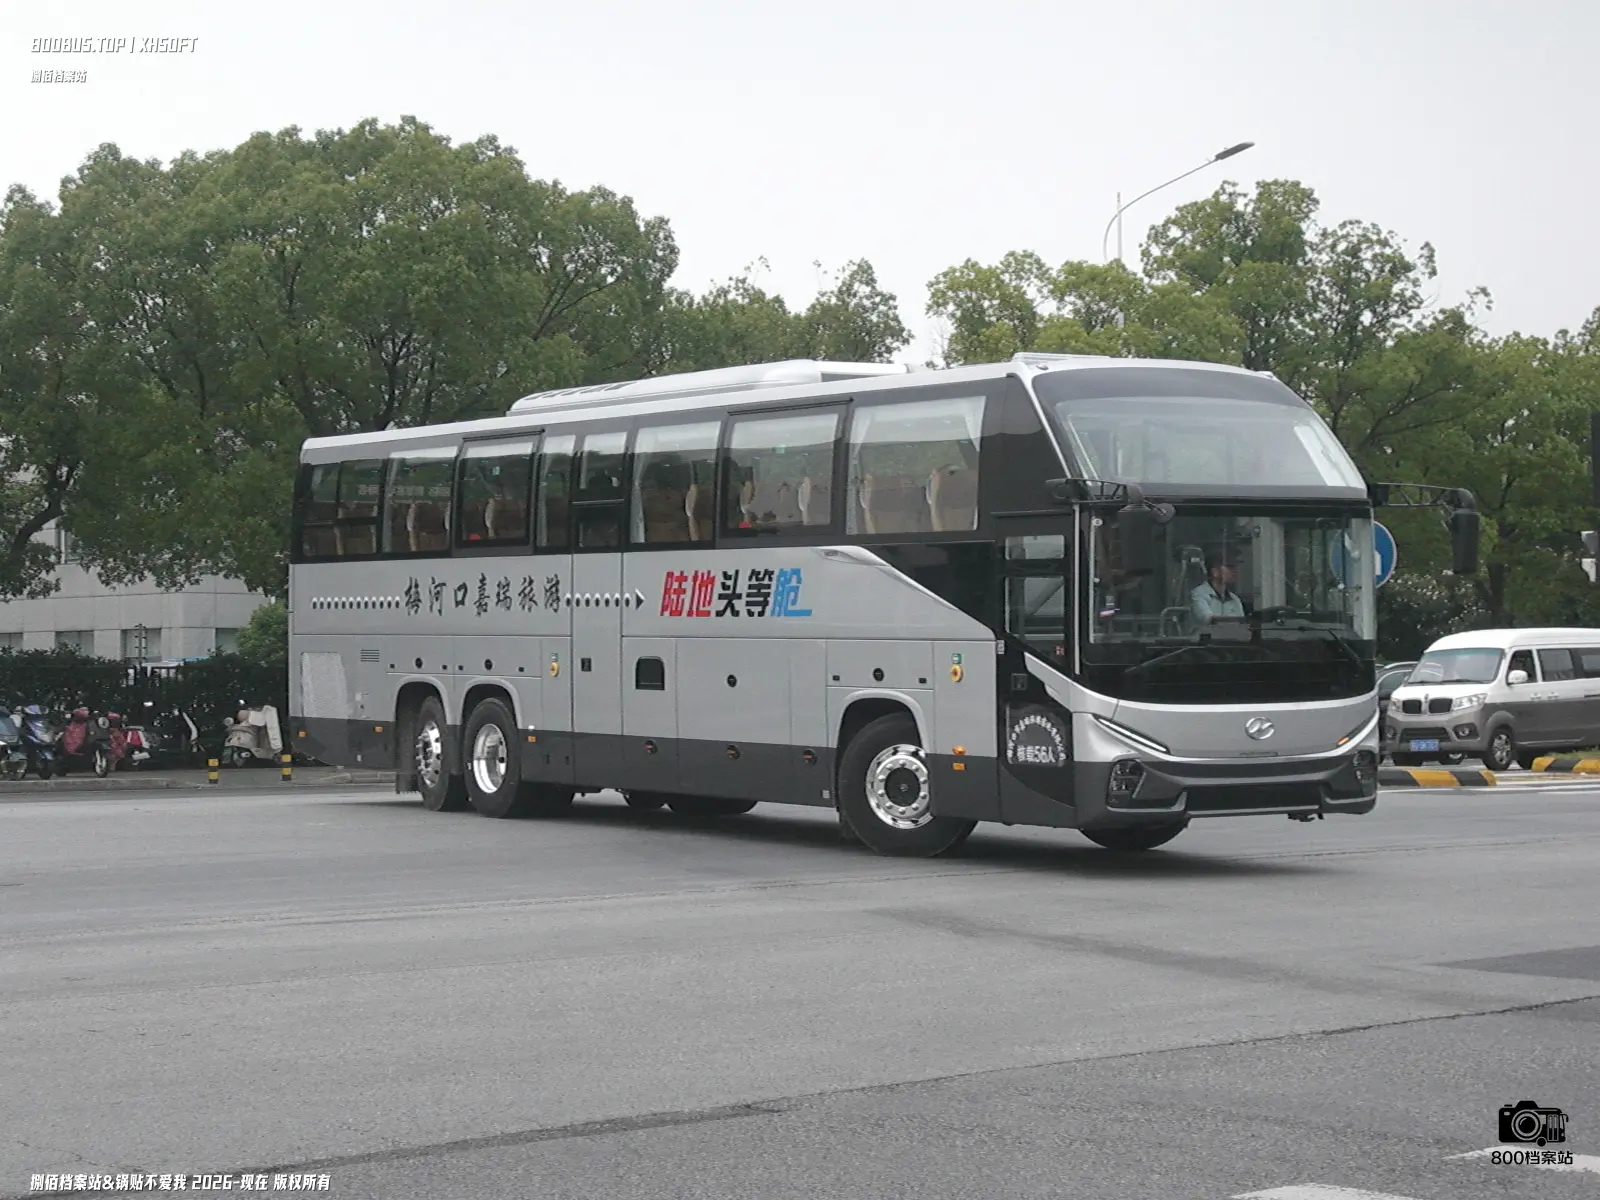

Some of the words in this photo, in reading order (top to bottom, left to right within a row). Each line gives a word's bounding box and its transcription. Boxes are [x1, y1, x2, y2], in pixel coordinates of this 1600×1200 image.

[660, 567, 813, 618] 陆地头等舱
